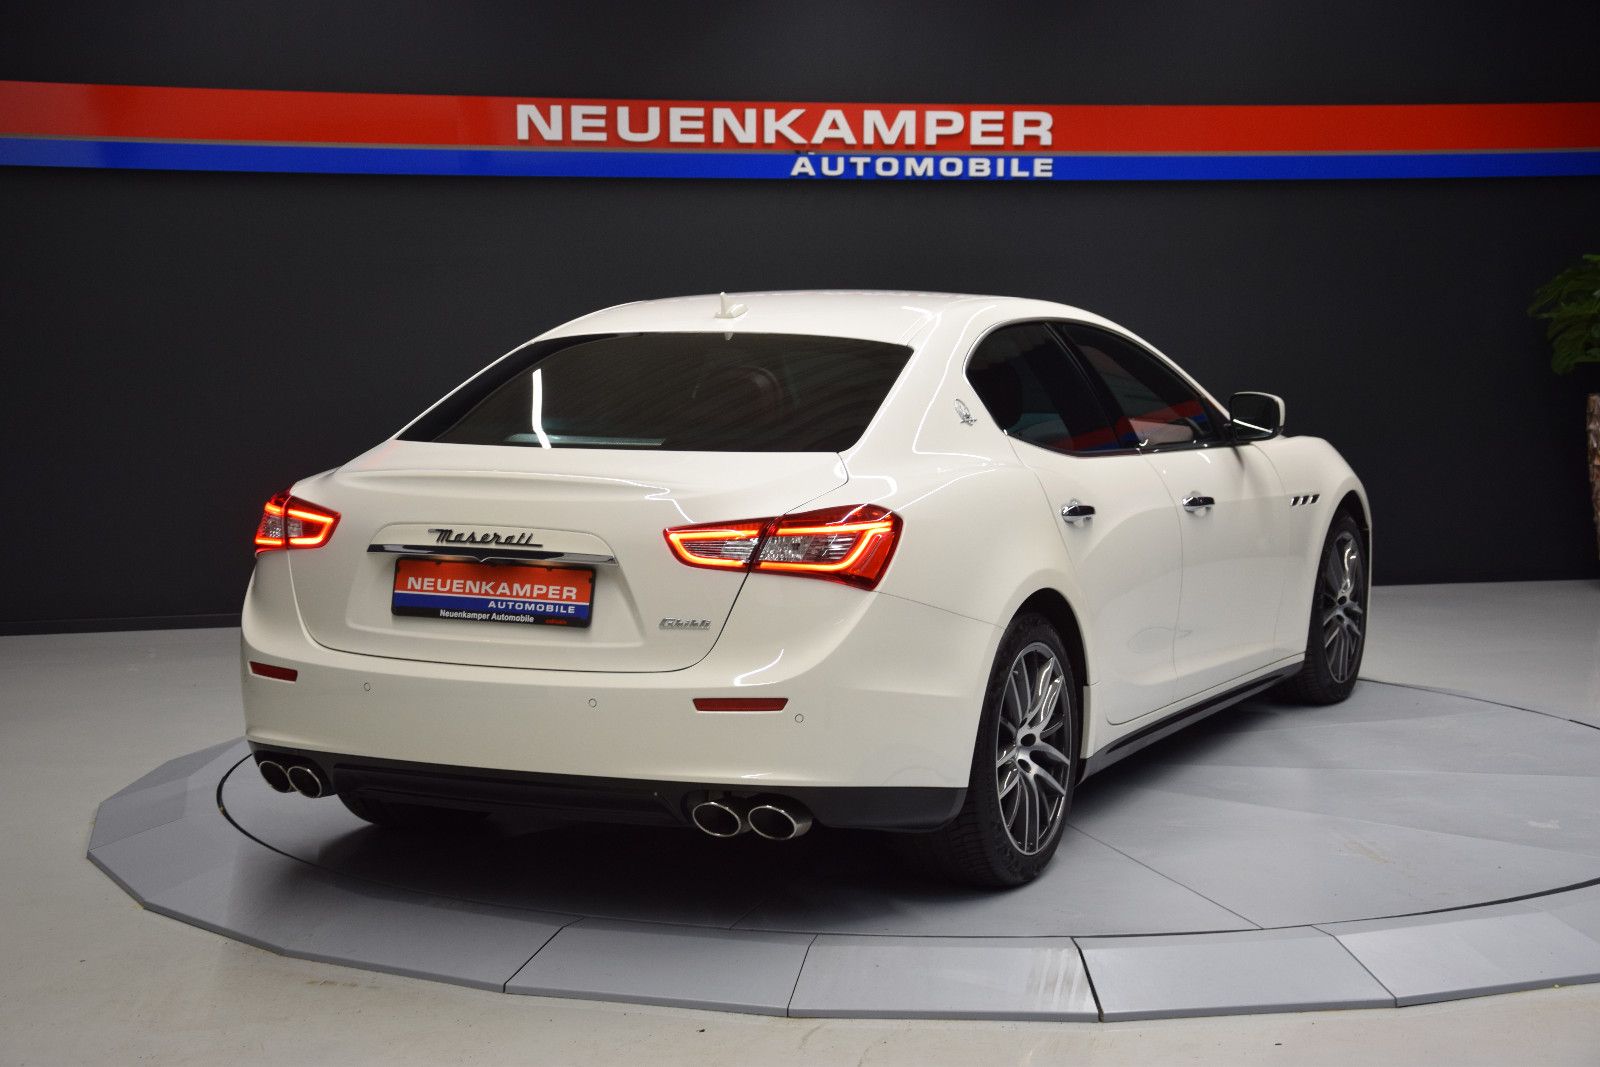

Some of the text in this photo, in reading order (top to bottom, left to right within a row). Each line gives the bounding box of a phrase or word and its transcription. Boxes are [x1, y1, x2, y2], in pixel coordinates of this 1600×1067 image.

[516, 104, 1053, 146] NEUENKAMPER
[791, 156, 1053, 178] AUTOMOBILE
[428, 528, 543, 547] Maserati
[407, 576, 577, 600] NEUENKAMPER
[439, 609, 490, 621] Neuenkamper
[491, 611, 535, 623] Automobile
[488, 600, 576, 614] AUTOMOBILE
[658, 617, 712, 630] Ghibli
